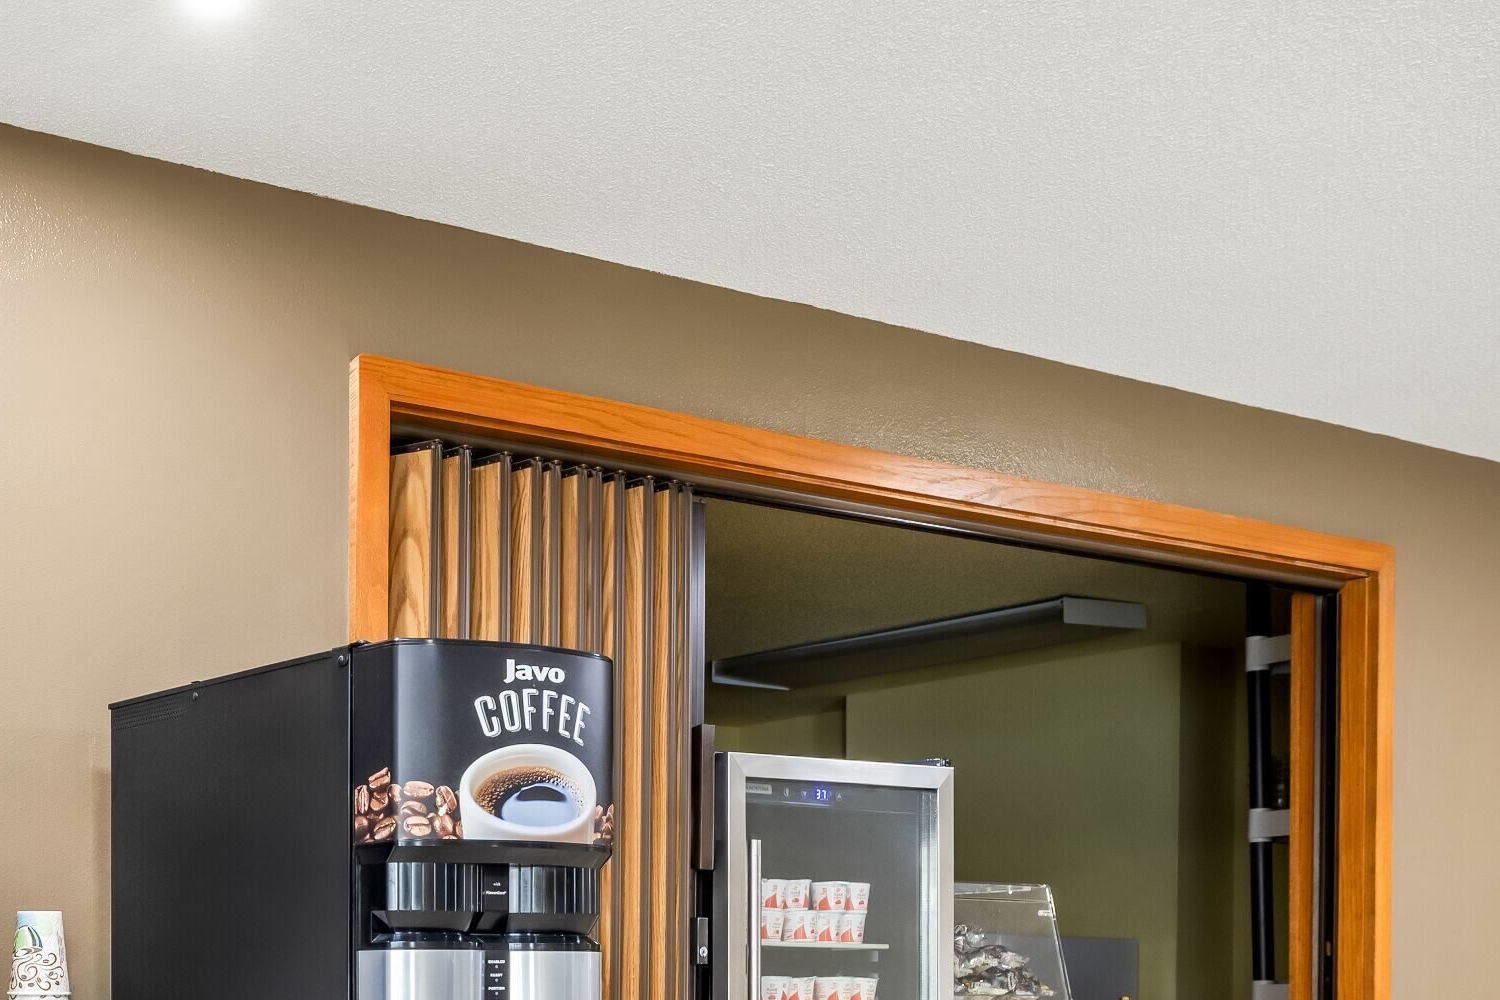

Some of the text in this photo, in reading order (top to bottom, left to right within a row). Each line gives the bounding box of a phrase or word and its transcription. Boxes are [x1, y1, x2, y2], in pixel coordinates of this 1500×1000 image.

[503, 658, 566, 684] Javo
[473, 688, 592, 747] COFFEE
[816, 788, 827, 800] 37
